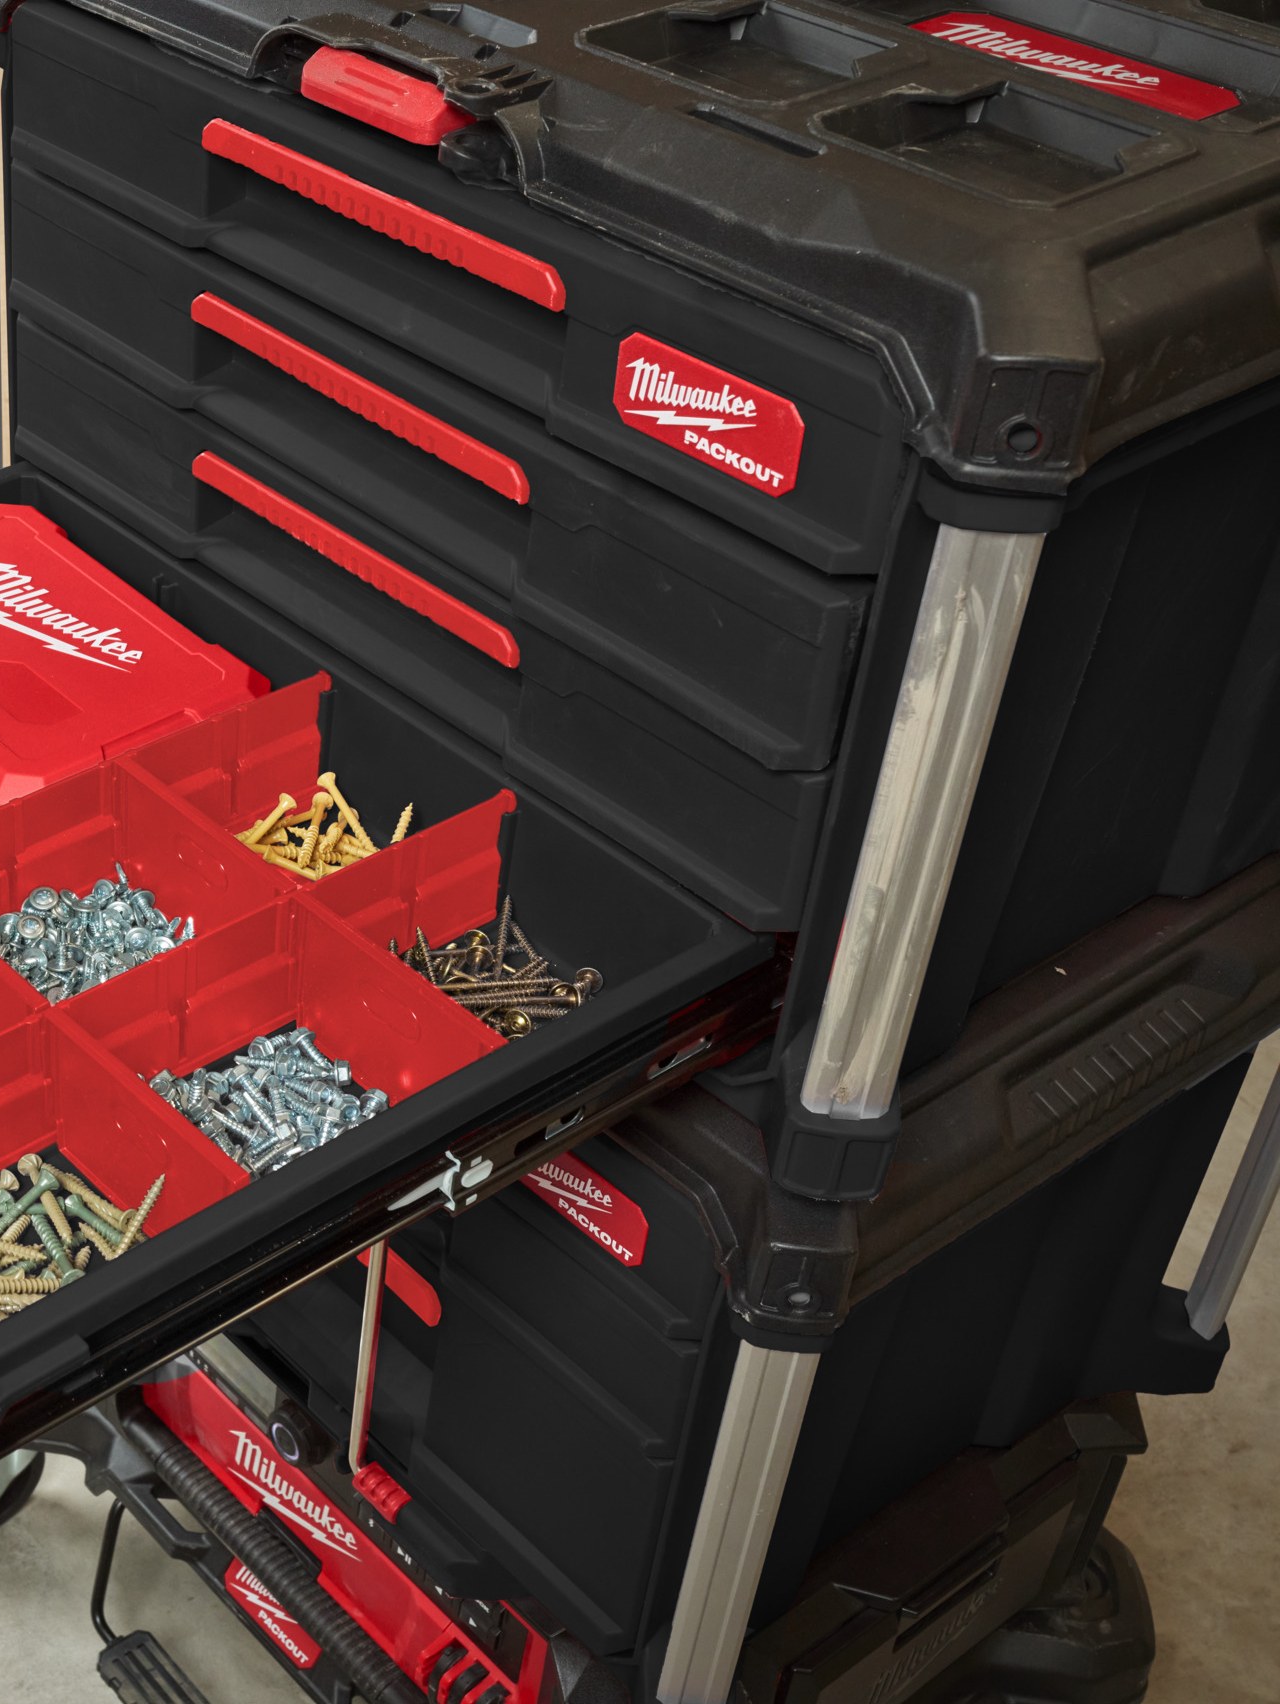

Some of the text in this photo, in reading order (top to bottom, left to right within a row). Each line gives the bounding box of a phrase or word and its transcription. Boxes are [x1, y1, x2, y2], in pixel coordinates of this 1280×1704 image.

[931, 21, 1160, 87] Milwaukee
[625, 356, 757, 418] Milwaukee
[683, 429, 784, 488] PACKOUT
[537, 1161, 613, 1208] lwaukee
[558, 1197, 634, 1262] PACKOUT
[228, 1429, 358, 1551] Milwaukee
[257, 1609, 310, 1665] PACKOUT
